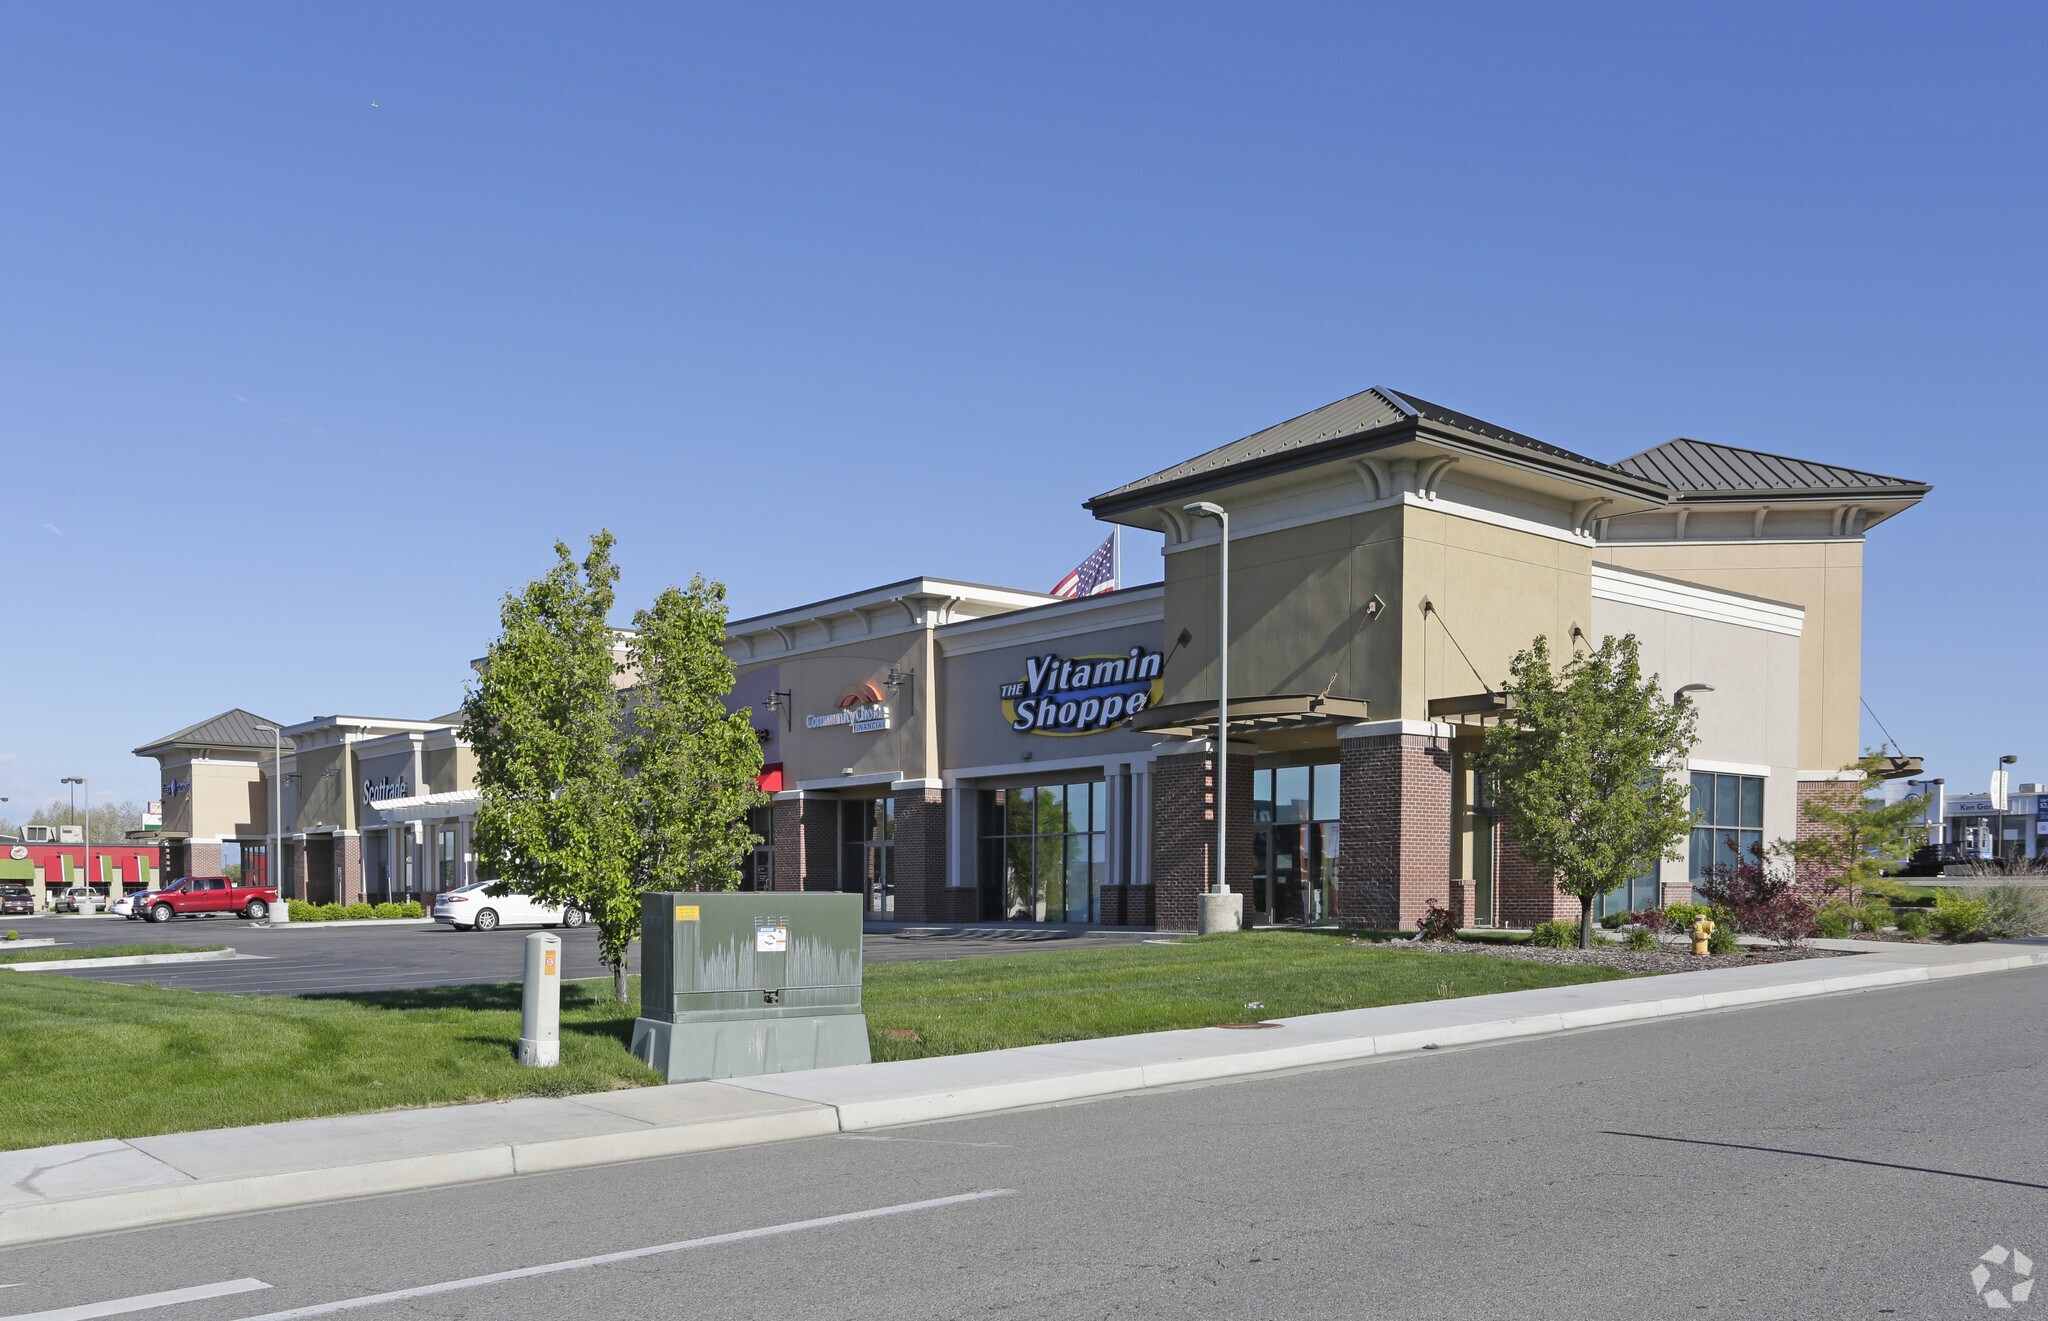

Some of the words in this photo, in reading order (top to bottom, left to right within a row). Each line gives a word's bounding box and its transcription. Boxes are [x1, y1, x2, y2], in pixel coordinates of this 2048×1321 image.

[1001, 682, 1024, 698] THE
[1026, 647, 1163, 695] Vitamin
[1013, 691, 1148, 731] Shoppe
[854, 720, 886, 732] FINANCIAL
[363, 776, 406, 805] Scottrade
[1960, 803, 1975, 811] Ken
